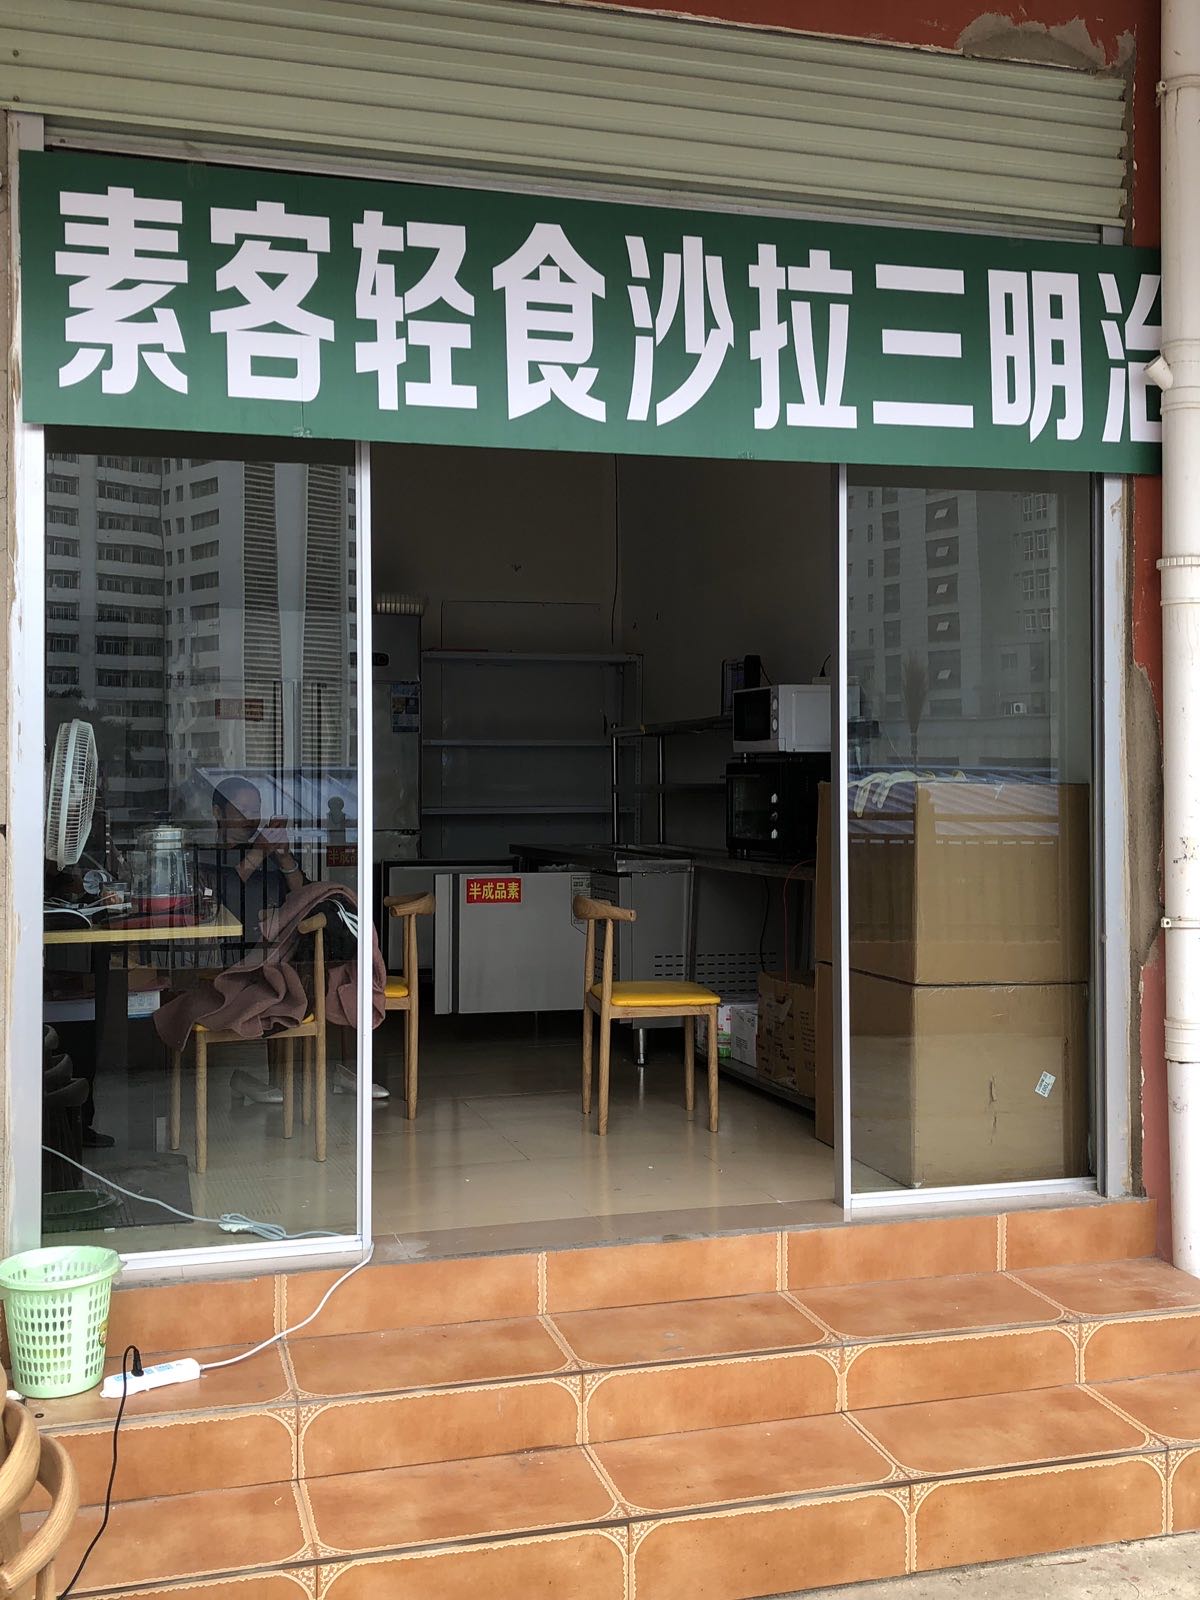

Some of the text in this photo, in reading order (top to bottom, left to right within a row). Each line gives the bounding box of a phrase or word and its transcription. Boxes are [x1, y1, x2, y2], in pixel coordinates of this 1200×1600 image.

[55, 186, 1161, 443] 素客轻食沙拉三明治
[469, 882, 519, 900] 半成品素
